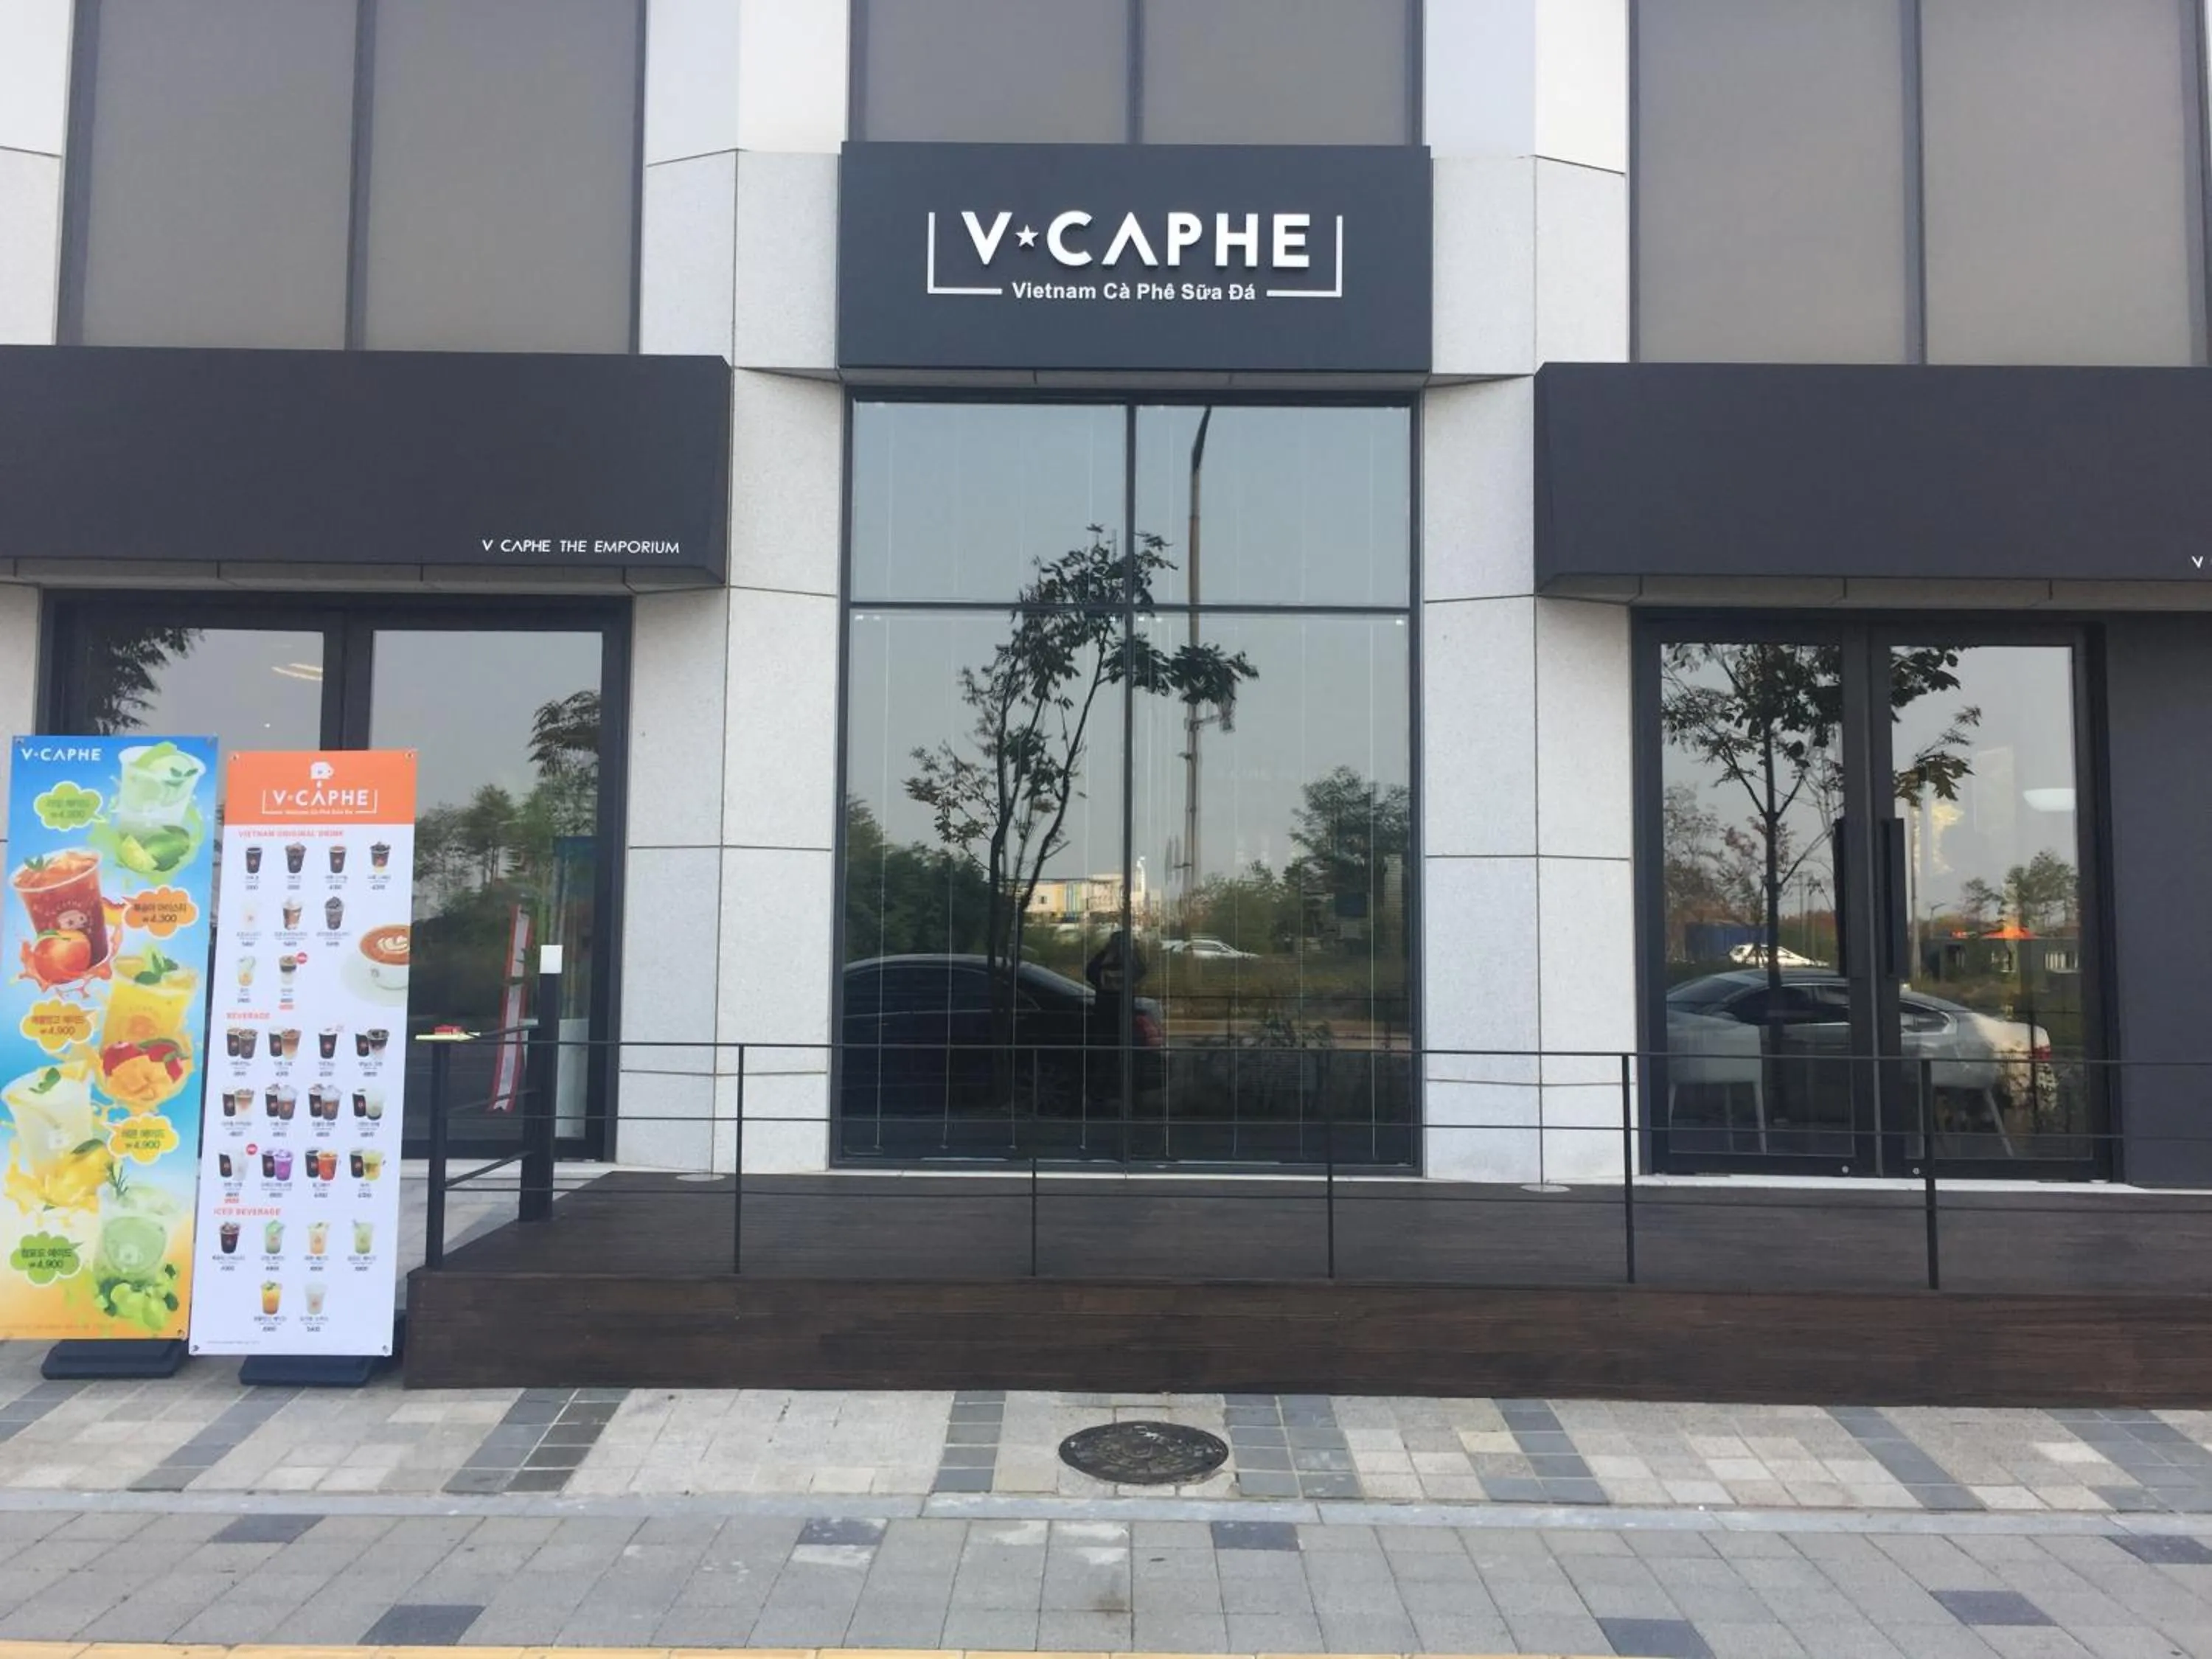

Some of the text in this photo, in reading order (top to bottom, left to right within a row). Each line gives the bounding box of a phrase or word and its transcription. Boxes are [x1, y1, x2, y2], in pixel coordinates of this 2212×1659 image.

[1012, 282, 1096, 299] Vietnam
[1104, 283, 1130, 299] Cà
[1138, 283, 1175, 299] Phê
[1228, 284, 1255, 299] Đá
[482, 540, 679, 553] V CAPHE THE EMPORIUM
[2192, 556, 2203, 568] V
